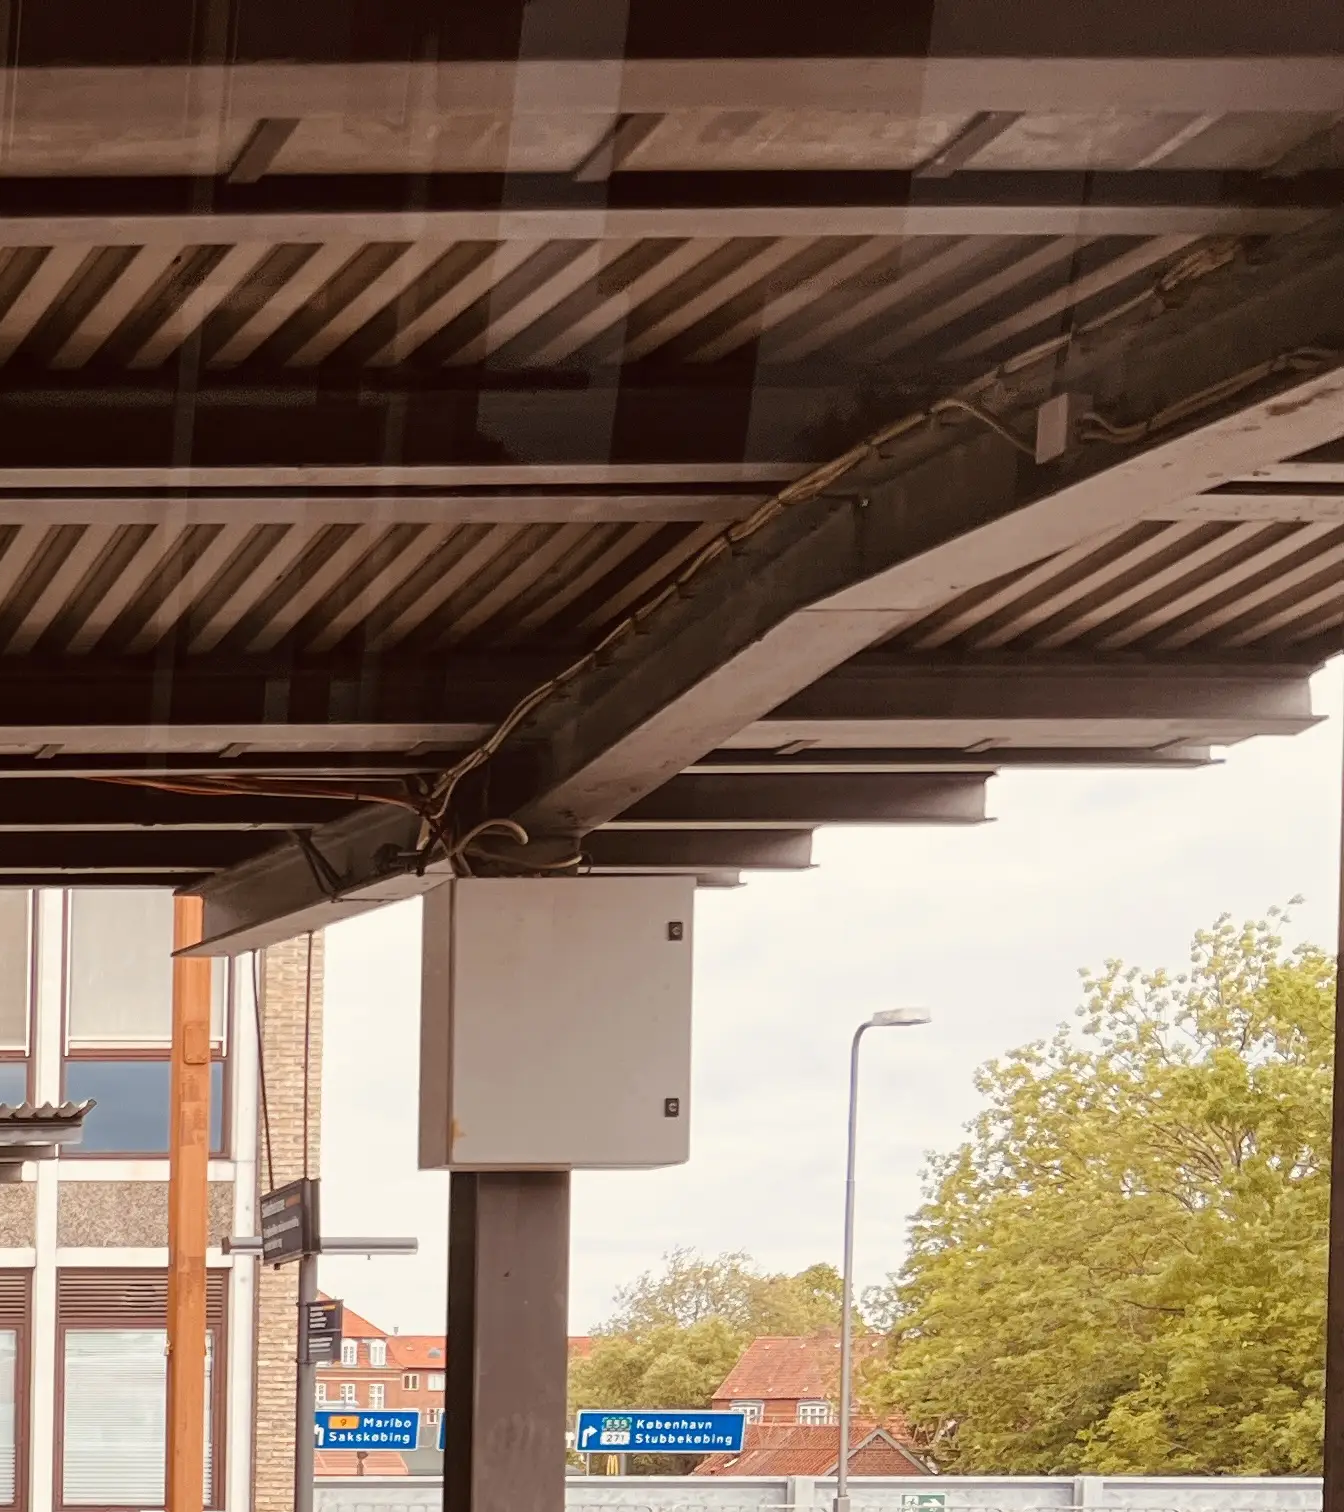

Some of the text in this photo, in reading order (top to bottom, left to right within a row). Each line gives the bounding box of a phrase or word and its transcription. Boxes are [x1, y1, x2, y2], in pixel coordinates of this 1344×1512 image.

[363, 1417, 412, 1428] Maribo
[636, 1419, 713, 1430] København
[328, 1431, 411, 1444] Sakskøbing
[605, 1434, 733, 1446] 271 Stubbekøbing
